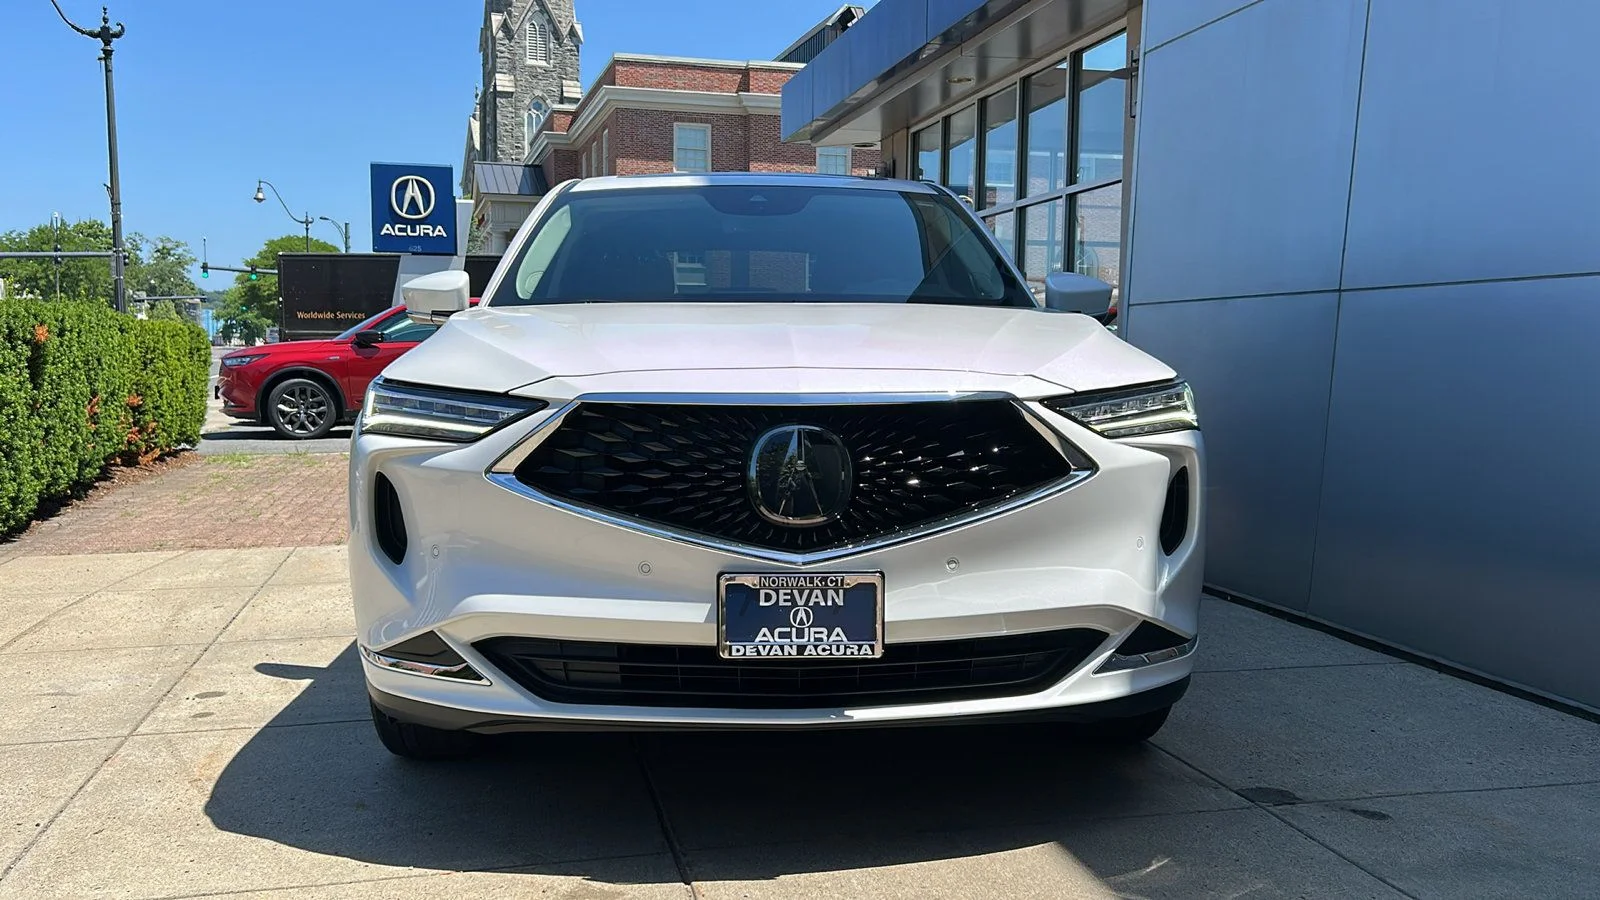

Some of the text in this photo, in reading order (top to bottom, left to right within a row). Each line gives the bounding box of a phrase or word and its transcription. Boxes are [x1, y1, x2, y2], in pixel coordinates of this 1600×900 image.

[380, 223, 447, 237] ACURA
[297, 311, 366, 319] Worldwide Services
[828, 576, 843, 587] CT
[759, 589, 844, 606] DEVAN
[754, 627, 848, 642] ACURA
[731, 644, 873, 656] DEVAN ACURA
